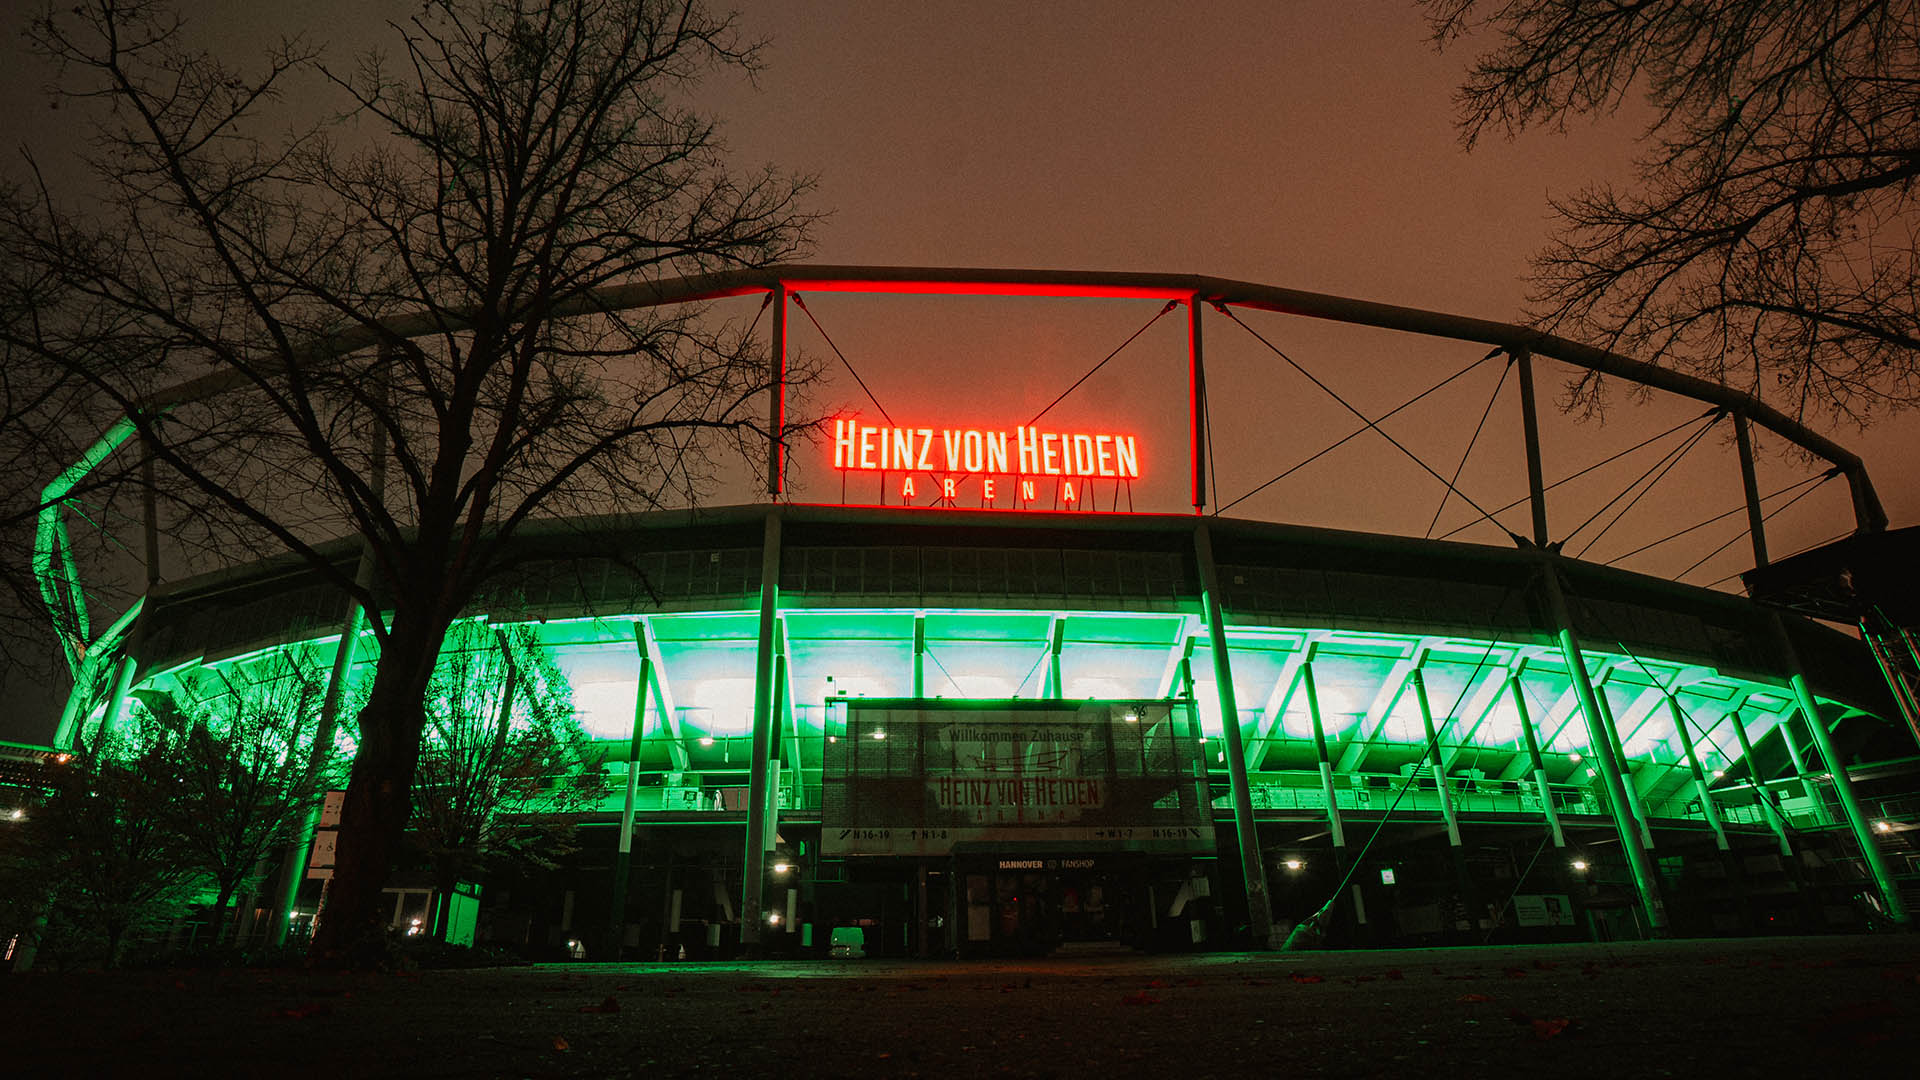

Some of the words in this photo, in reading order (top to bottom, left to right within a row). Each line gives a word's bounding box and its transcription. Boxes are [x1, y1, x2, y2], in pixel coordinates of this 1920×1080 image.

[834, 419, 934, 470] HEINZ
[943, 429, 1008, 474] VON
[1017, 425, 1139, 478] HEIDEN
[902, 476, 1076, 502] ARENA
[949, 728, 1026, 742] Willkommen
[1031, 729, 1085, 742] Zuhause
[853, 830, 861, 840] N
[863, 830, 890, 840] 16-19
[922, 830, 930, 840] N
[932, 830, 948, 840] 1-8
[1152, 828, 1161, 839] N
[999, 859, 1044, 871] HANNOVER
[1062, 859, 1096, 870] FANSHOP
